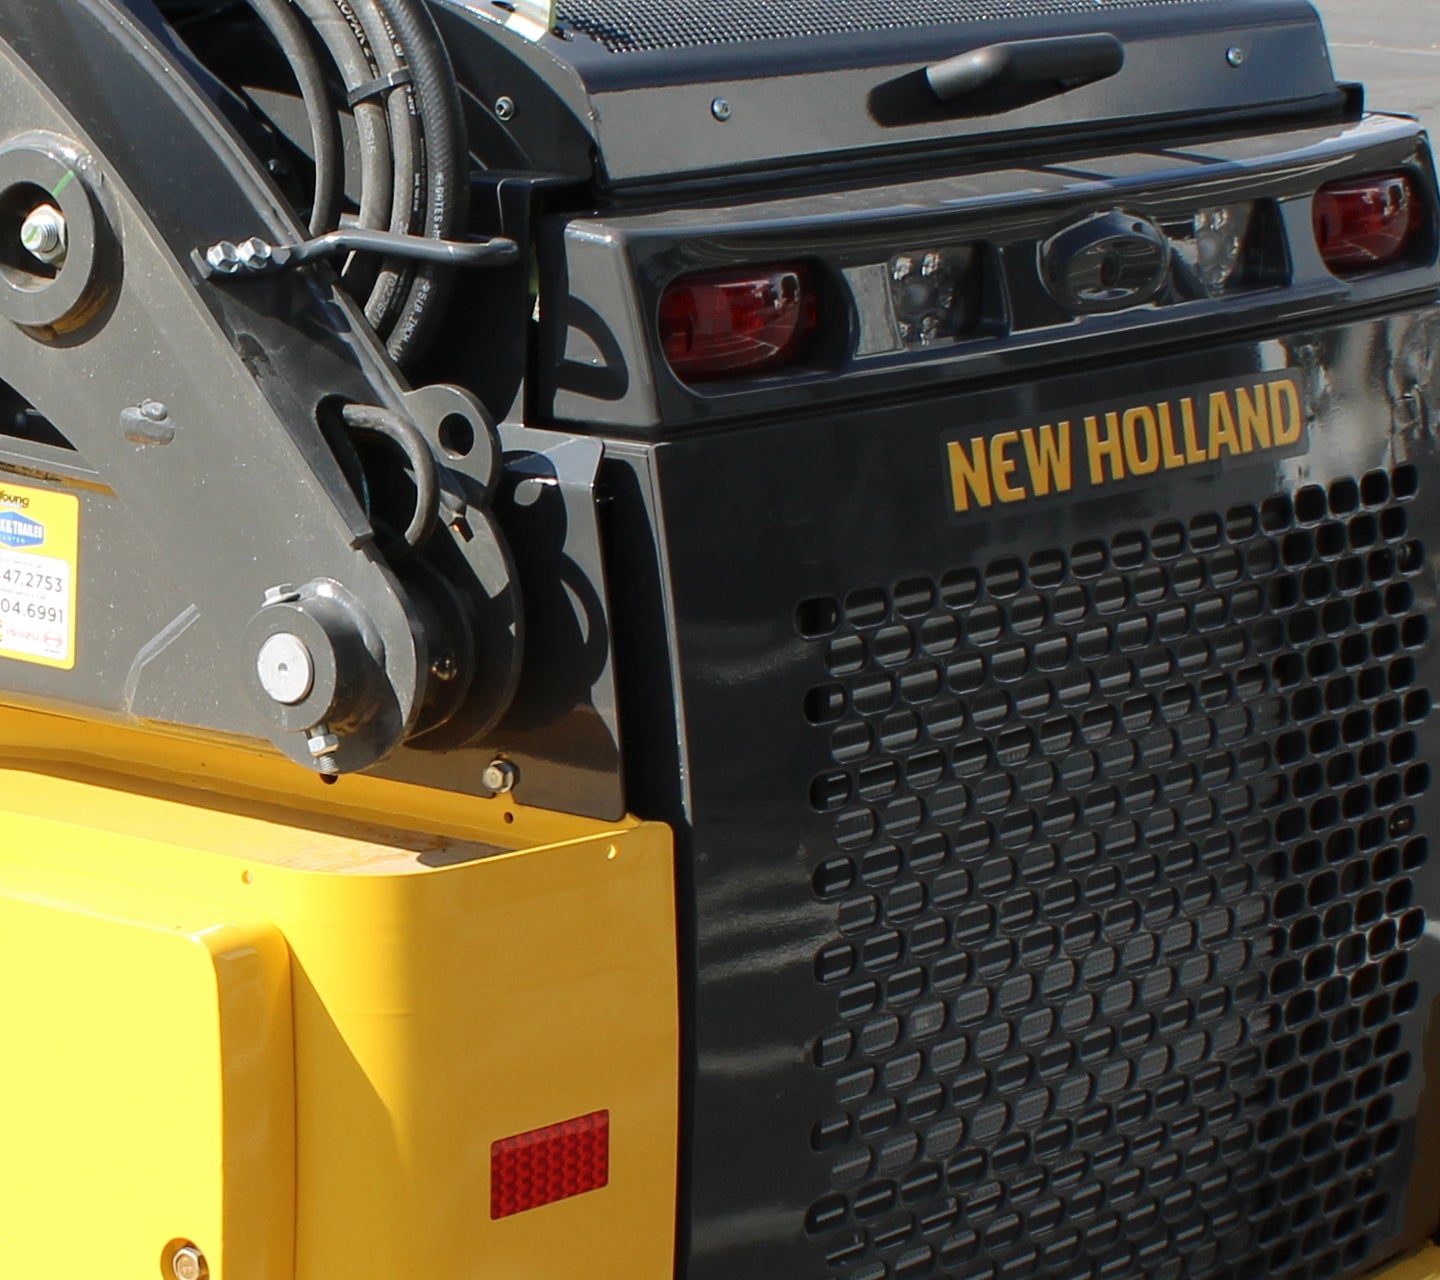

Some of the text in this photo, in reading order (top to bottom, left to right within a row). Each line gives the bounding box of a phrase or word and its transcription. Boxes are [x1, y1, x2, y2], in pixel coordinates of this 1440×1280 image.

[433, 186, 445, 223] GATES
[946, 378, 1304, 512] NEW HOLLAND
[6, 628, 39, 641] ISUZU
